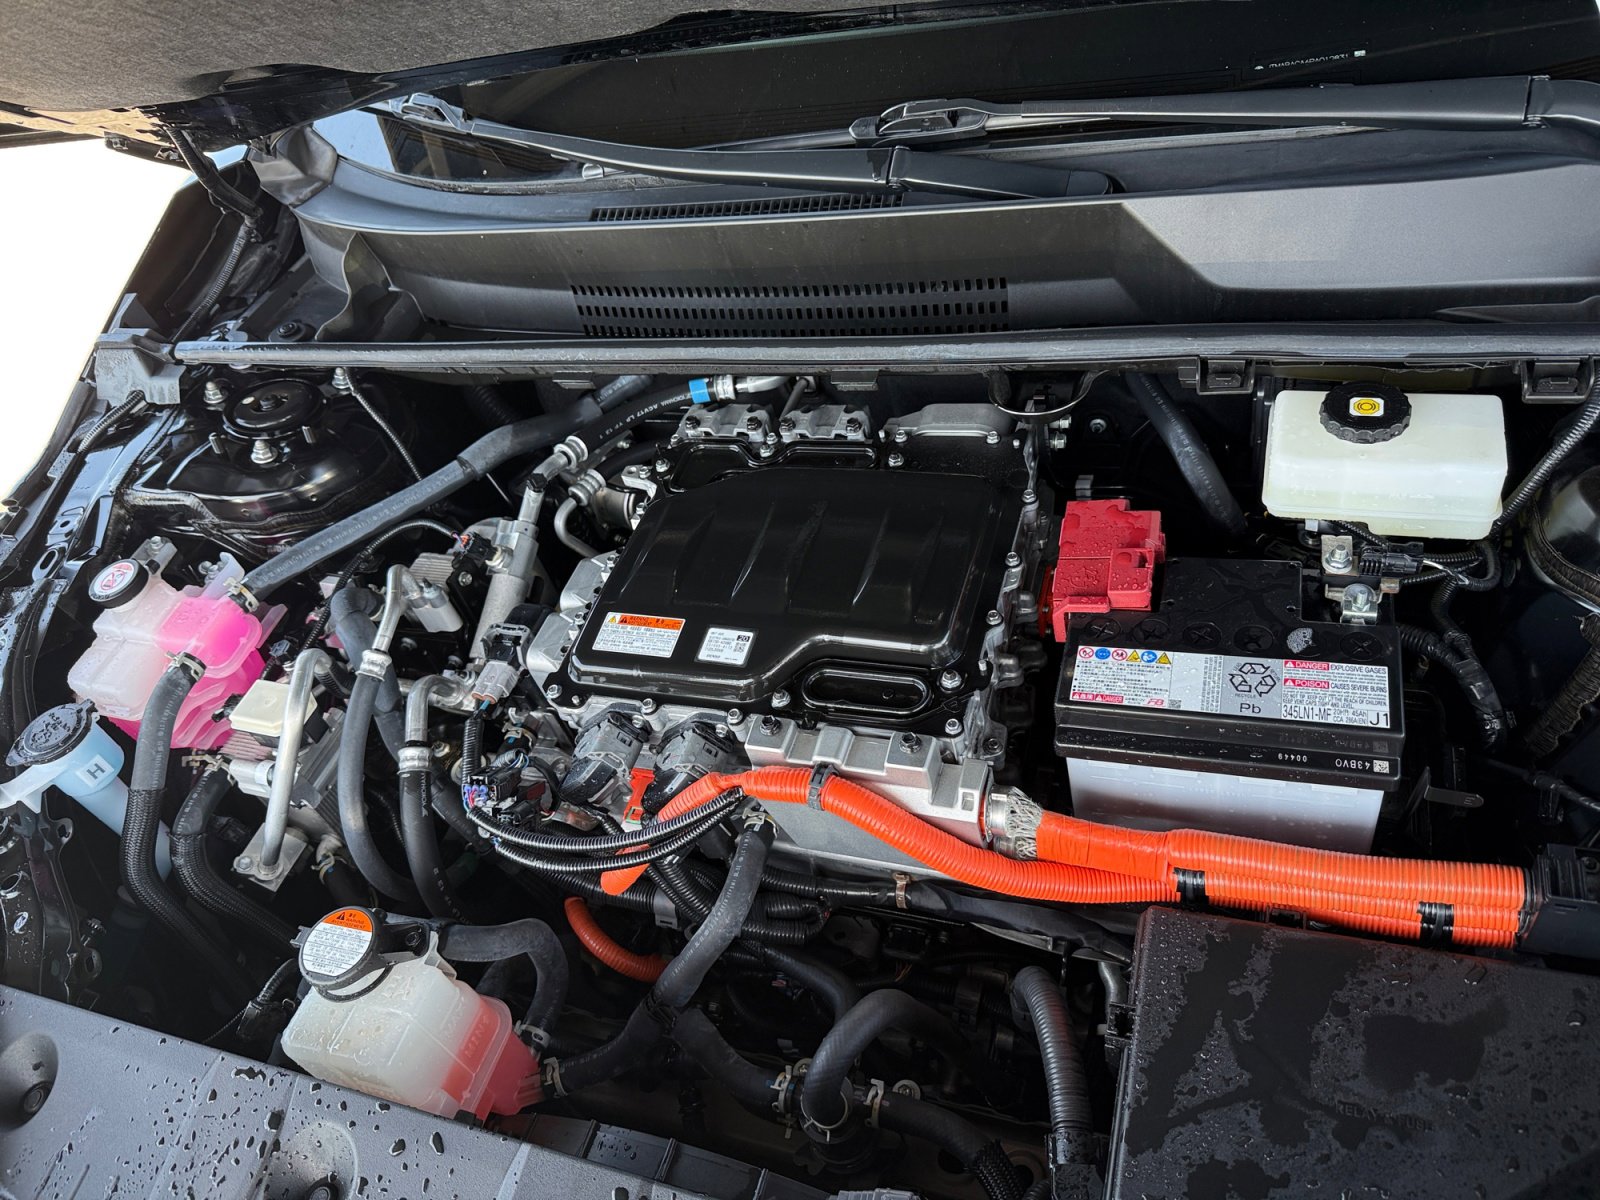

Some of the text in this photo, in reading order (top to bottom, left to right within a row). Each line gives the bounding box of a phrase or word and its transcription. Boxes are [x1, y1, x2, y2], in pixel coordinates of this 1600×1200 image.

[1295, 662, 1328, 670] DANGER
[1330, 664, 1363, 672] EXPLOSIVE
[1294, 680, 1388, 694] POISON CAUSES SEVERE BURNS
[1102, 695, 1122, 703] DANGER
[1240, 702, 1262, 714] Pb
[1282, 704, 1332, 721] 345LN1-MF
[1369, 712, 1389, 726] J1
[86, 763, 106, 780] H
[1336, 1100, 1378, 1120] RELAY
